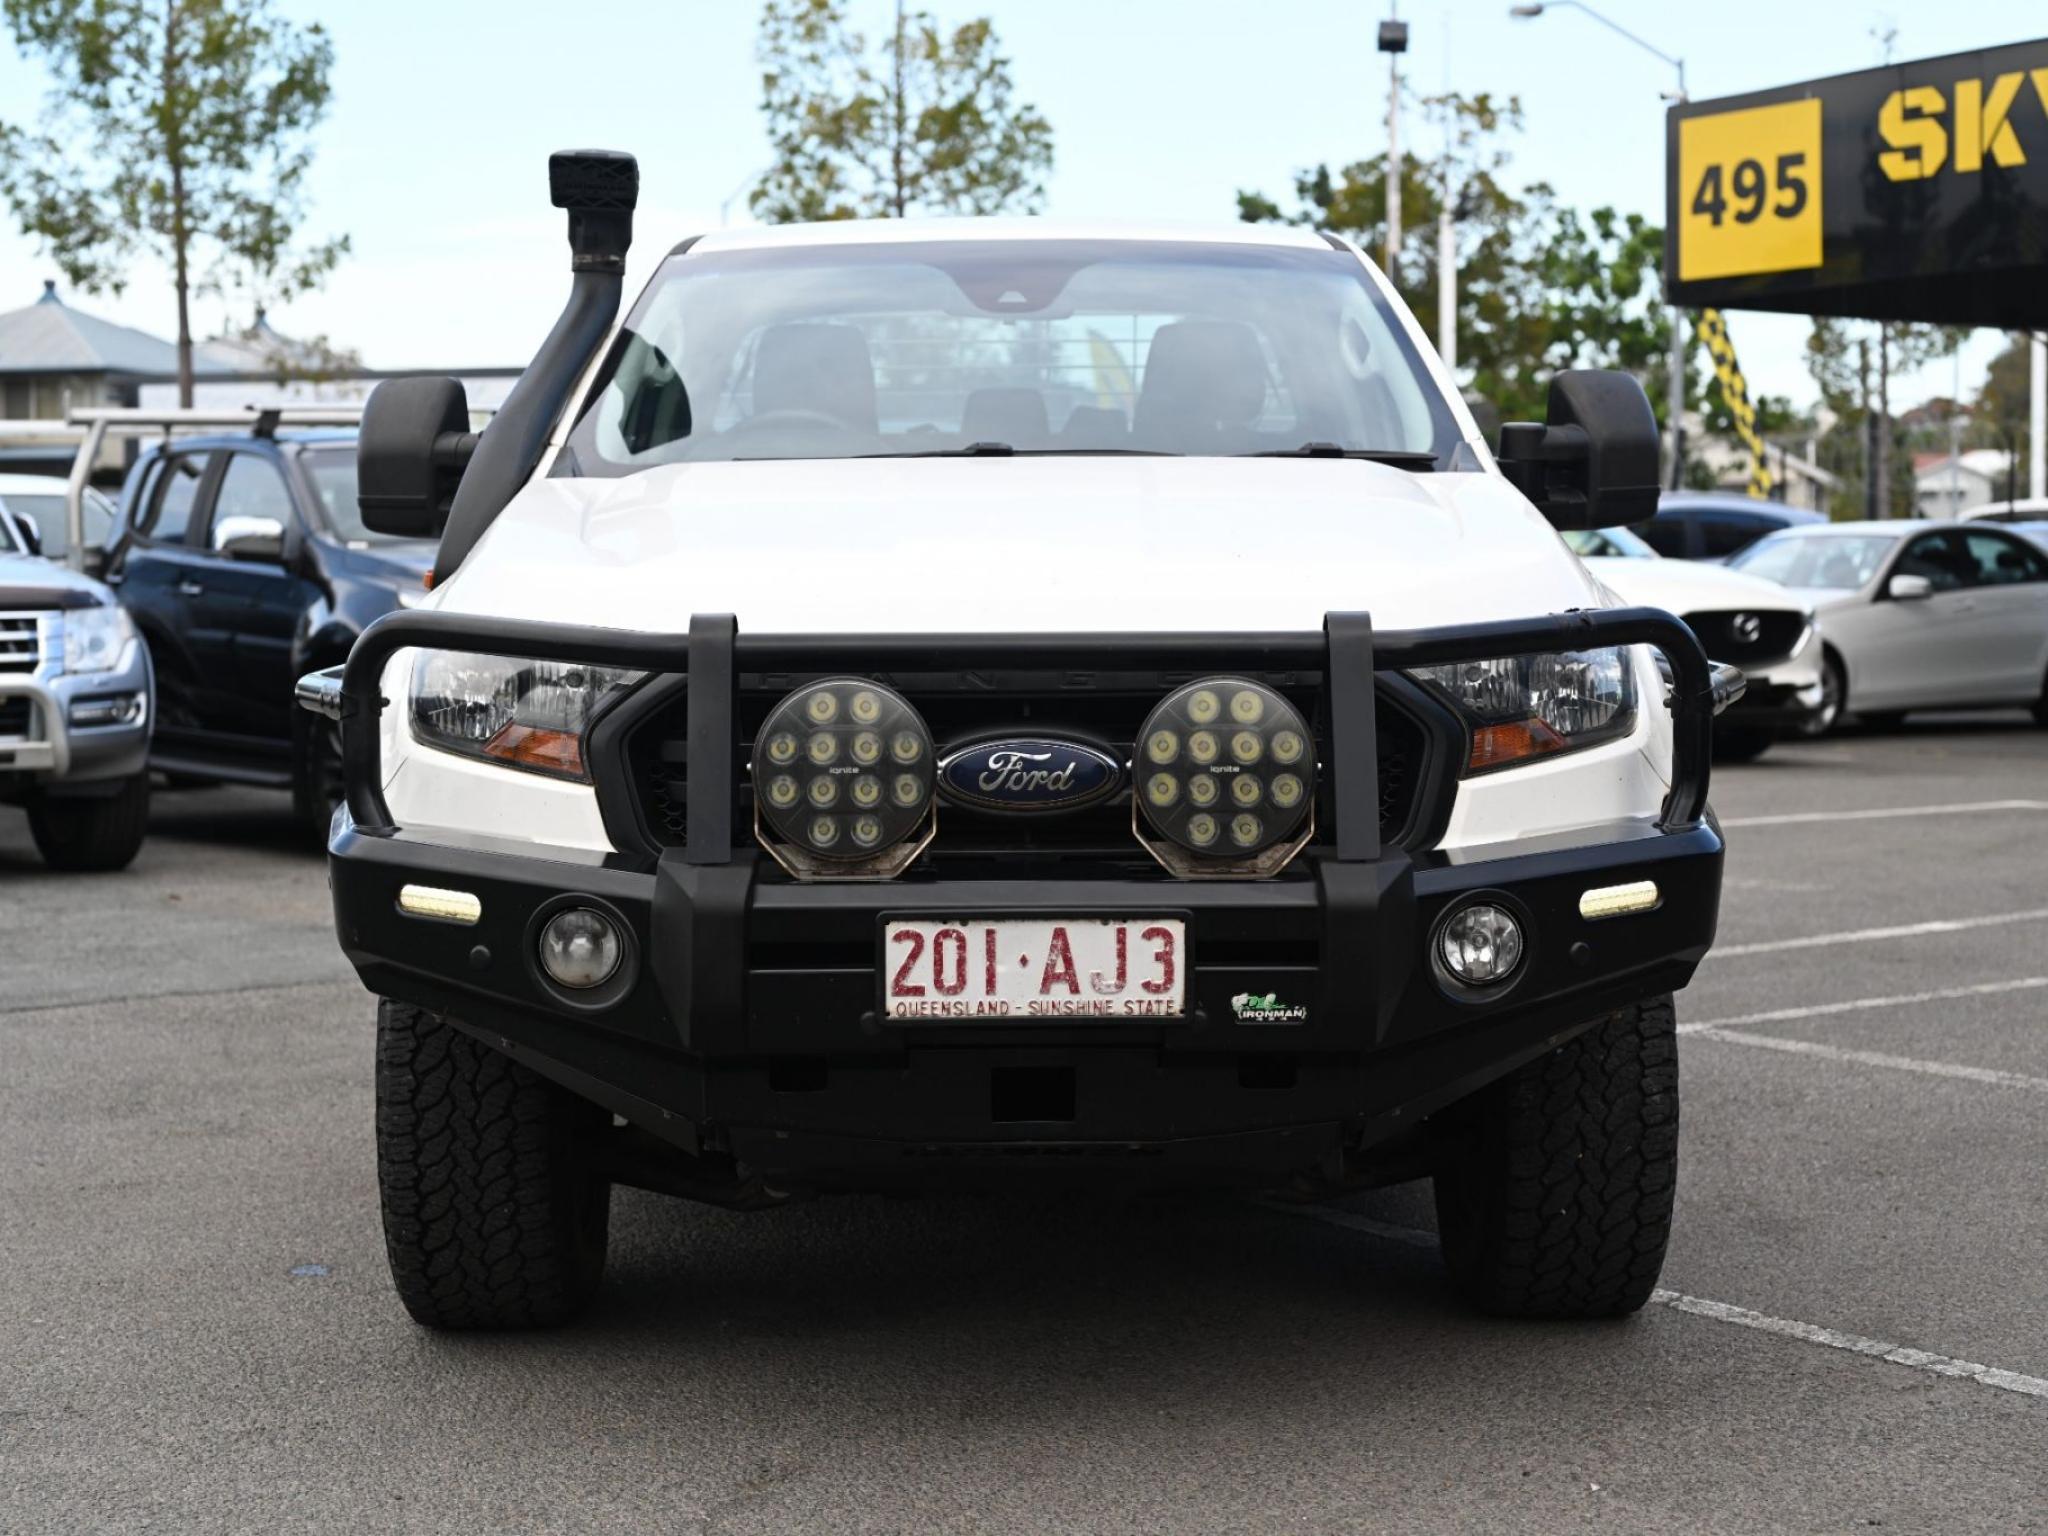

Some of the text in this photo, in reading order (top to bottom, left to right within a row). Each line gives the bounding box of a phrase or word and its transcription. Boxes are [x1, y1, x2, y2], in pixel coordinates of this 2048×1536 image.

[1878, 67, 2048, 182] SK
[1691, 152, 1807, 227] 495
[979, 751, 1076, 790] Ford
[896, 1001, 1009, 1016] QUEENSLAND
[1028, 1000, 1114, 1015] SUNSHINE
[1124, 999, 1174, 1015] STATE
[1240, 1009, 1303, 1018] IRONMAN
